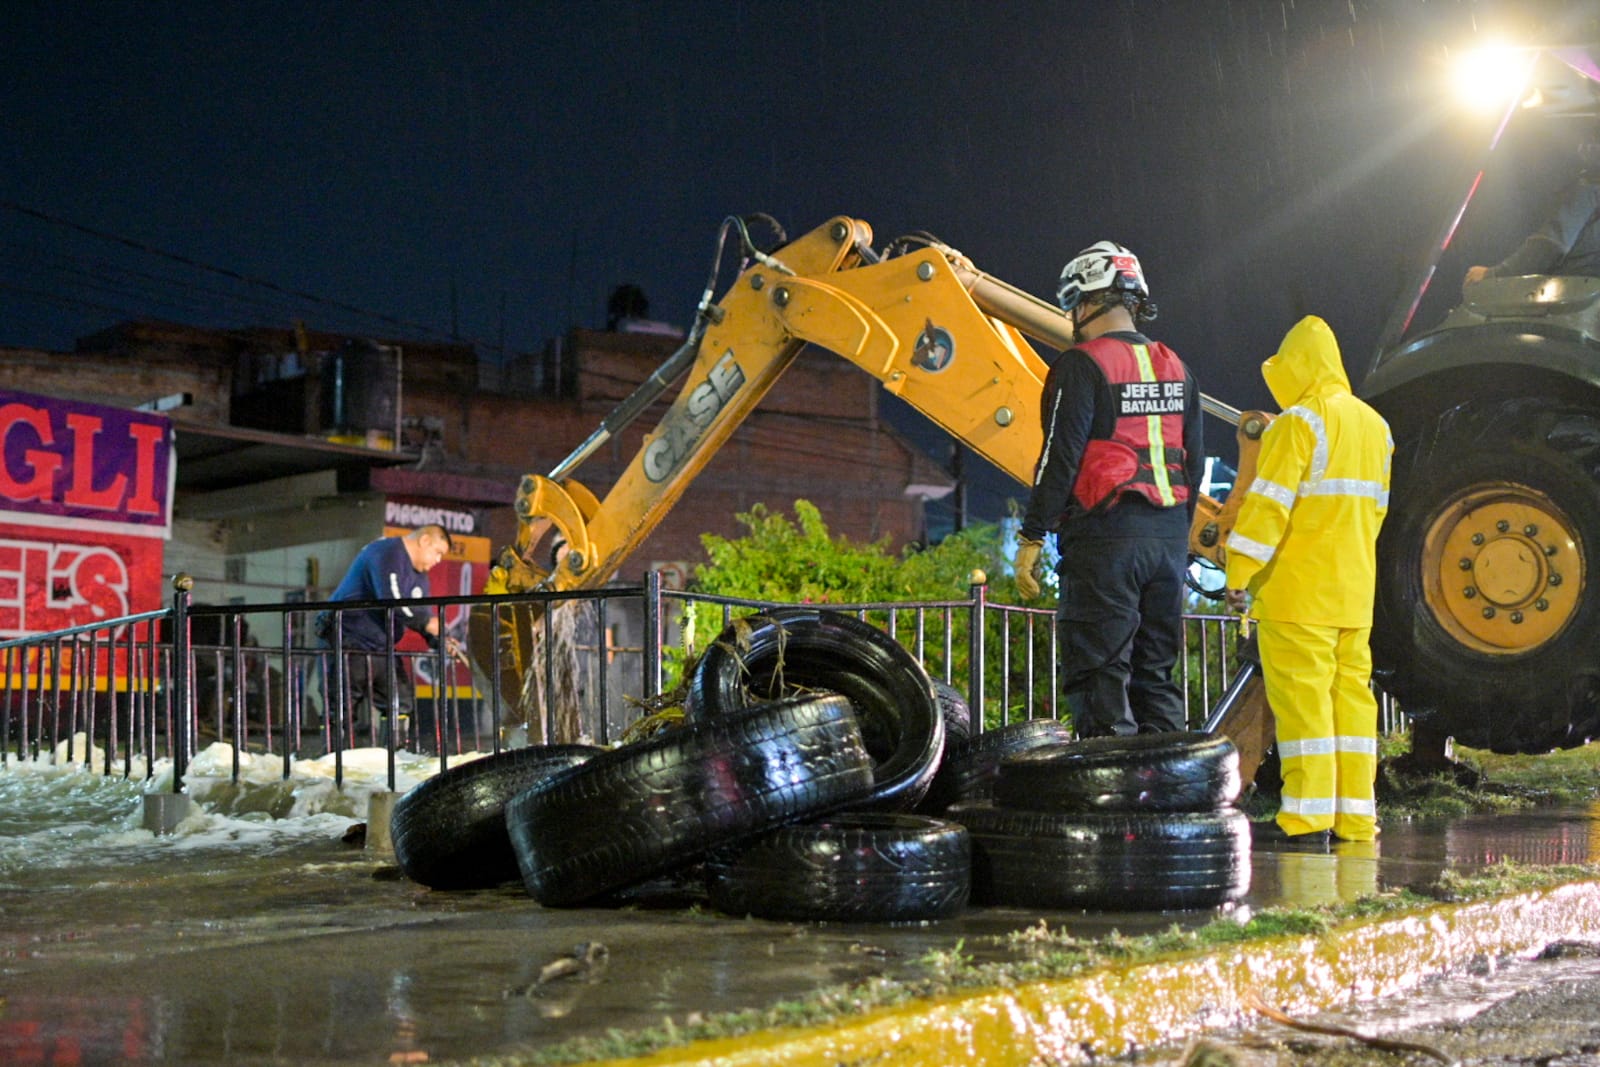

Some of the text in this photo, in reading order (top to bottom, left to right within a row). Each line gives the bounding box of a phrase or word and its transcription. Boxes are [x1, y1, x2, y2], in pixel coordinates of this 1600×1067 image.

[1121, 382, 1184, 398] JEFE DE
[1121, 398, 1184, 414] BATALLÓN
[643, 347, 746, 483] CASE
